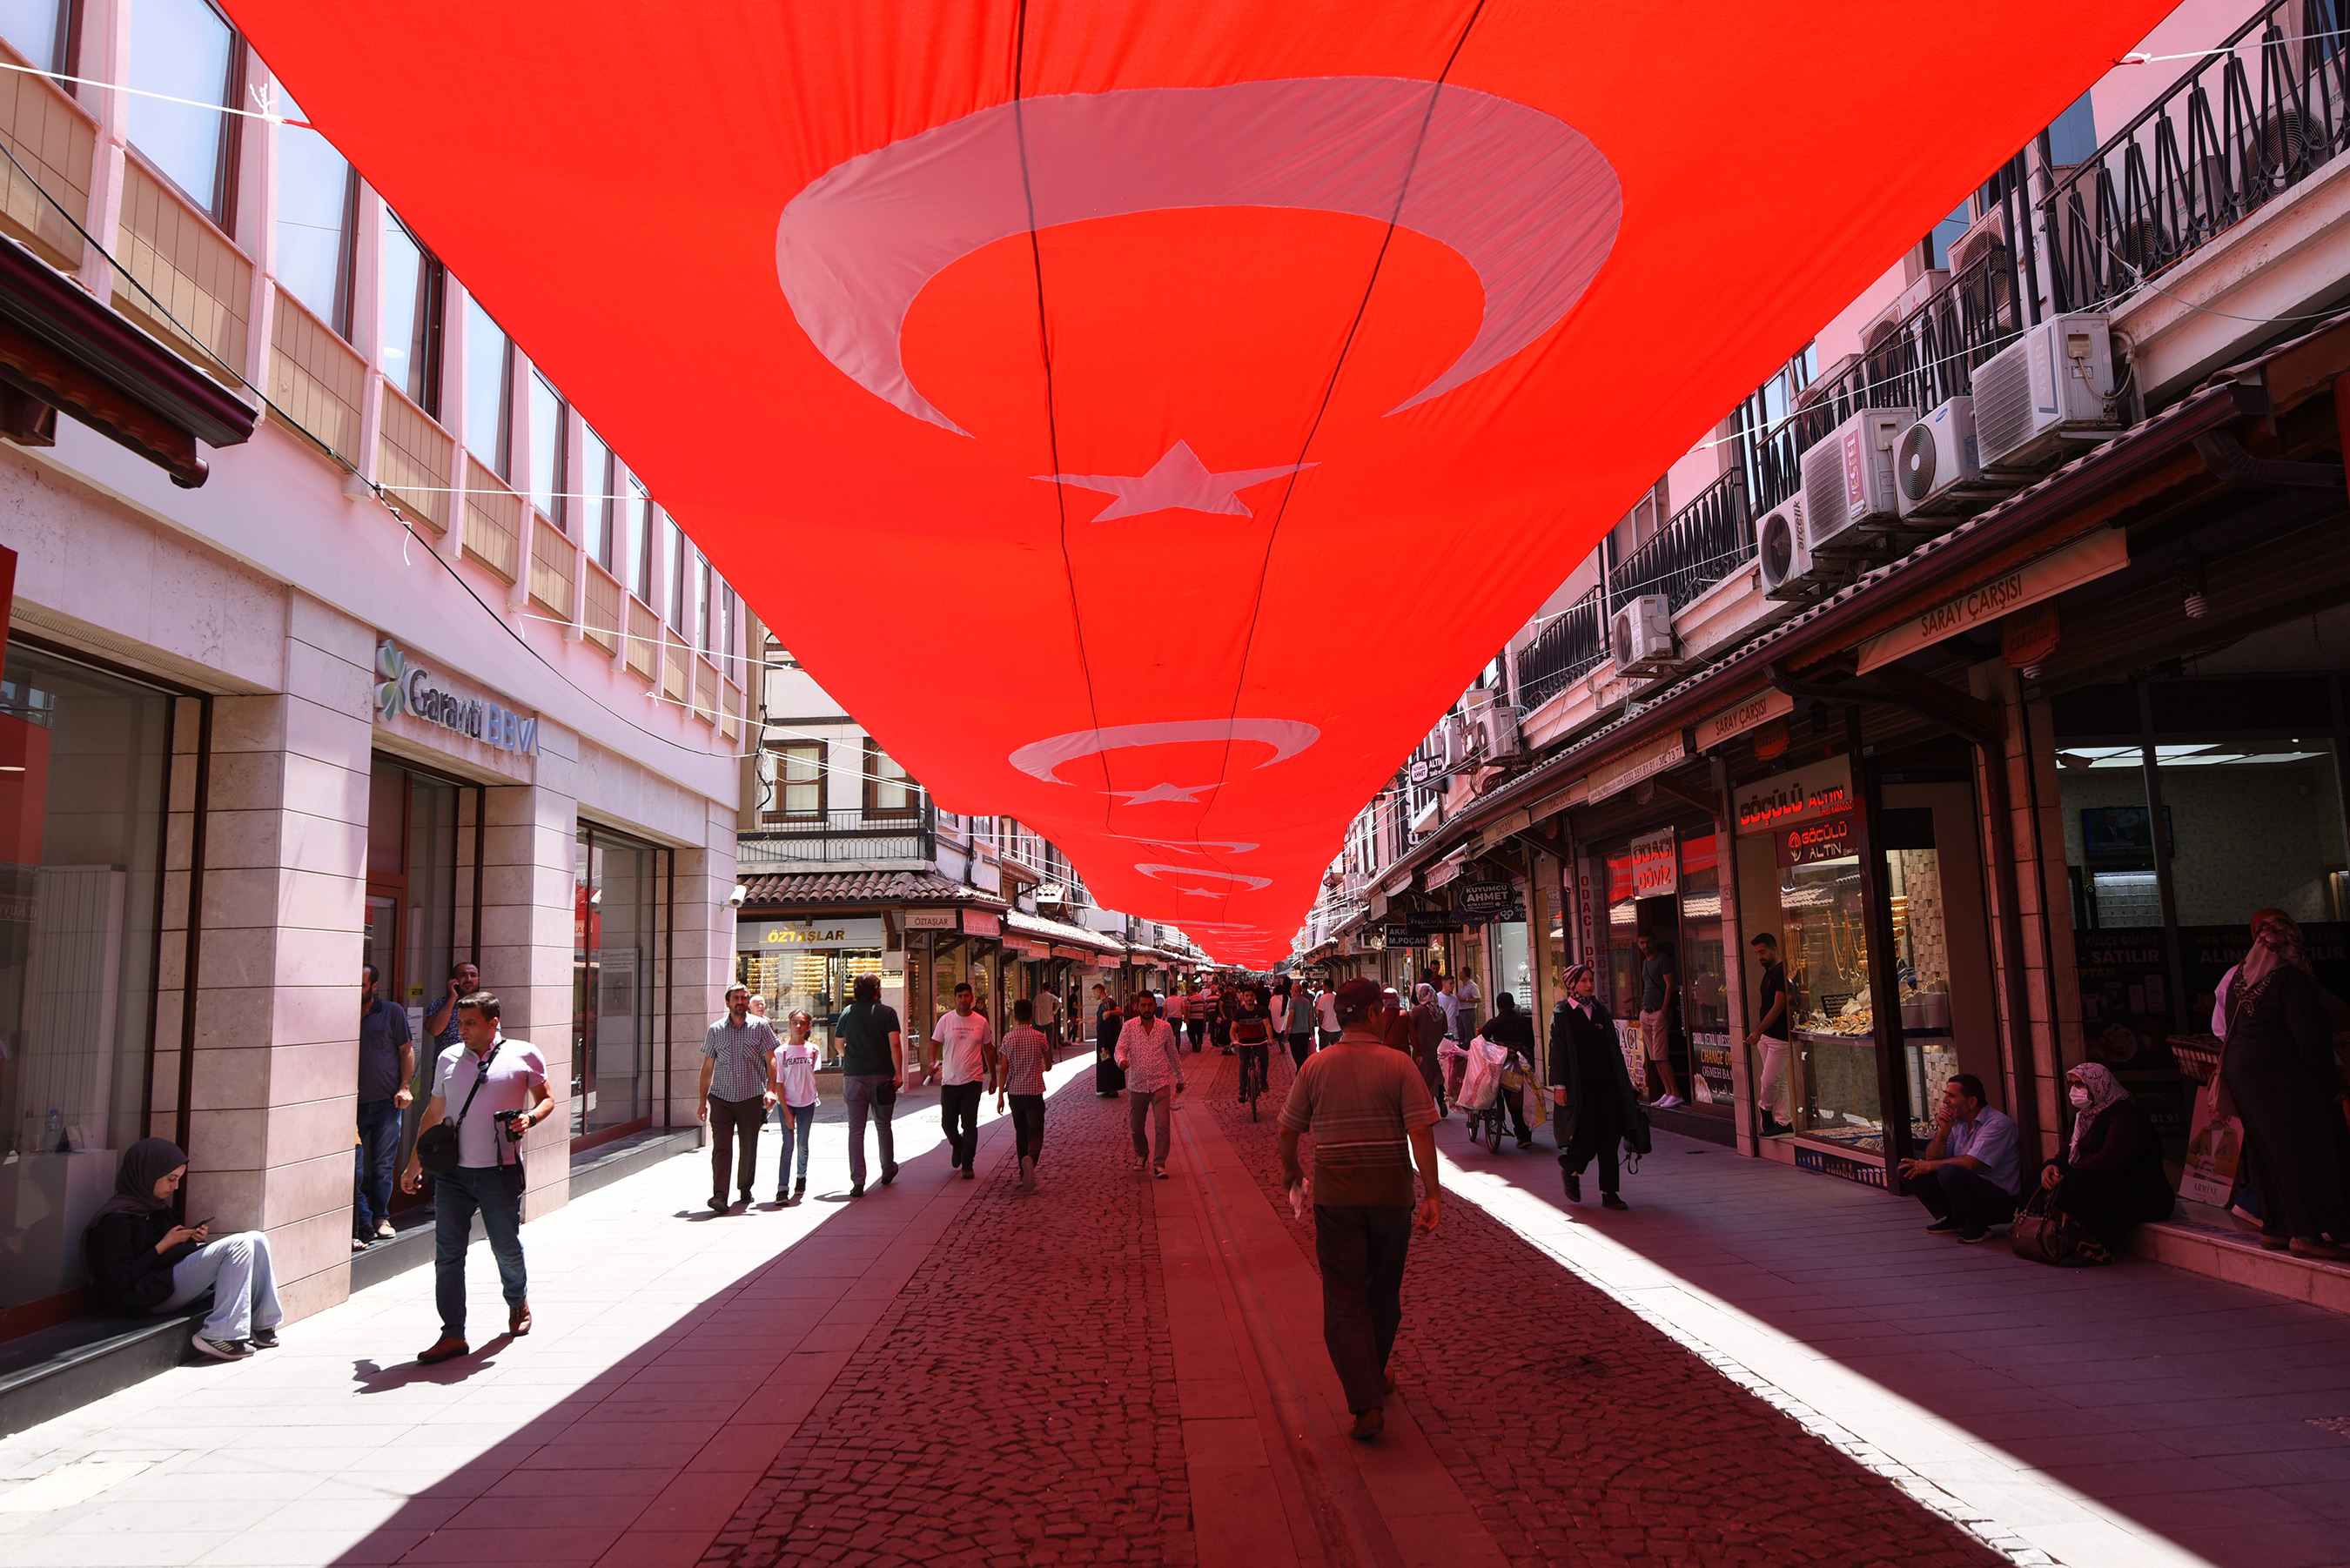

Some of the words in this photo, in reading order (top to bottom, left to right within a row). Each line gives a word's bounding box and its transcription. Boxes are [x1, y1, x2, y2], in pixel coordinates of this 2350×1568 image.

[1847, 432, 1862, 504] VESTEL
[1793, 500, 1804, 550] arçelik
[1921, 600, 1963, 637] SARAY
[1967, 573, 2023, 621] ÇARŞISI
[404, 669, 482, 740] Garanti
[480, 702, 540, 755] BBVA
[1715, 712, 1737, 736] SARAY
[1739, 698, 1768, 728] ÇARŞISI
[1740, 783, 1803, 826] GÖÇÜLÜ
[1809, 784, 1844, 808] ALTIN
[1802, 821, 1849, 845] GÖÇÜLÜ
[1633, 836, 1674, 866] ODACI
[1810, 842, 1843, 859] ALTIN
[1638, 865, 1671, 889] DÖVİZ
[1466, 885, 1507, 894] KUYUMCU
[1467, 891, 1508, 902] AHMET
[1580, 875, 1592, 940] ODACI
[915, 917, 949, 927] ÖZTAŞLAR
[768, 929, 845, 944] ÖZTAŞLAR
[1389, 937, 1427, 946] M.POÇAN
[2092, 949, 2160, 964] SATILIR
[2078, 968, 2117, 978] PTAN
[784, 1056, 813, 1069] WHATEVE
[1701, 1049, 1723, 1065] CHANGE
[2151, 1114, 2164, 1122] 81
[2166, 1114, 2179, 1122] 91
